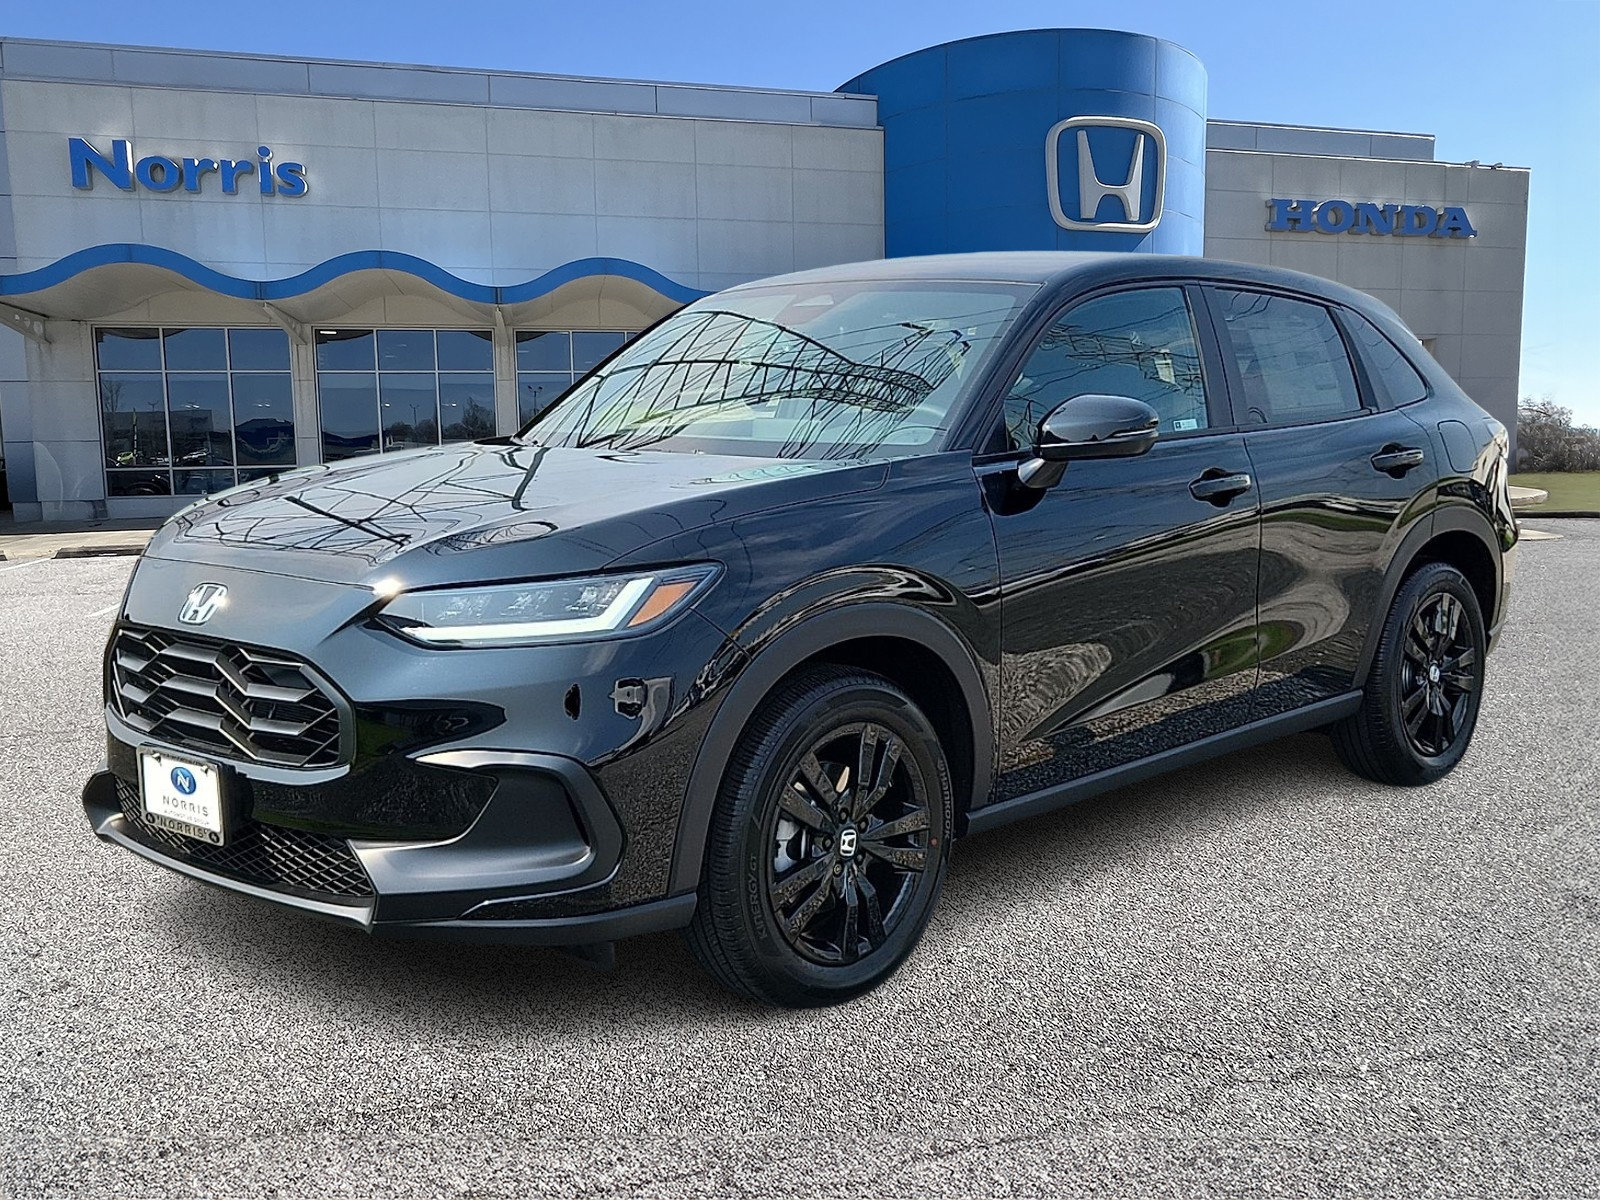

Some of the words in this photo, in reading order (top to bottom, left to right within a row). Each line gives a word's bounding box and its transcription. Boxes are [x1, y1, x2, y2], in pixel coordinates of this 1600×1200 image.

[68, 137, 309, 196] Norris
[1266, 198, 1478, 239] HONDA
[162, 795, 209, 817] NORRIS
